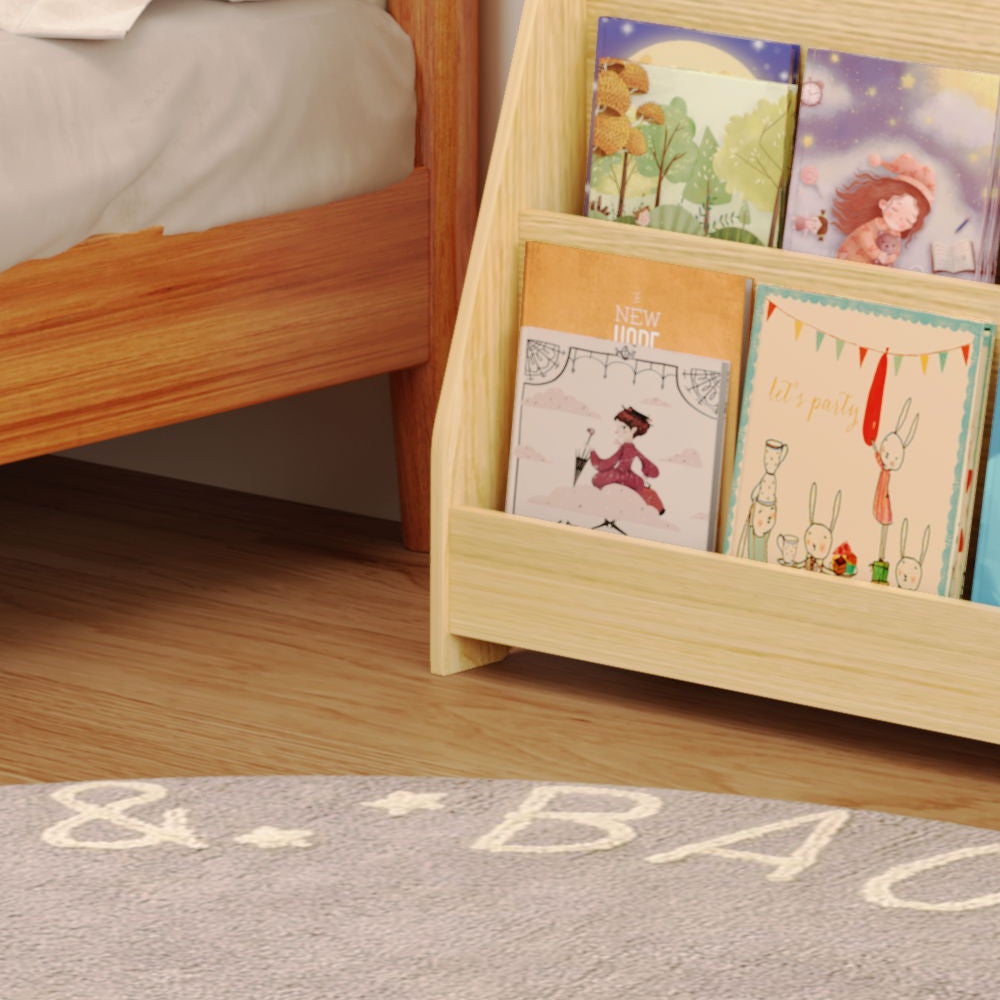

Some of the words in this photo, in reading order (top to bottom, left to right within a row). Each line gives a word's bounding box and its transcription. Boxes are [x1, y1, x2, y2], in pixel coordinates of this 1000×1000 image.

[615, 304, 662, 328] NEW
[806, 391, 859, 432] party
[41, 780, 208, 850] &
